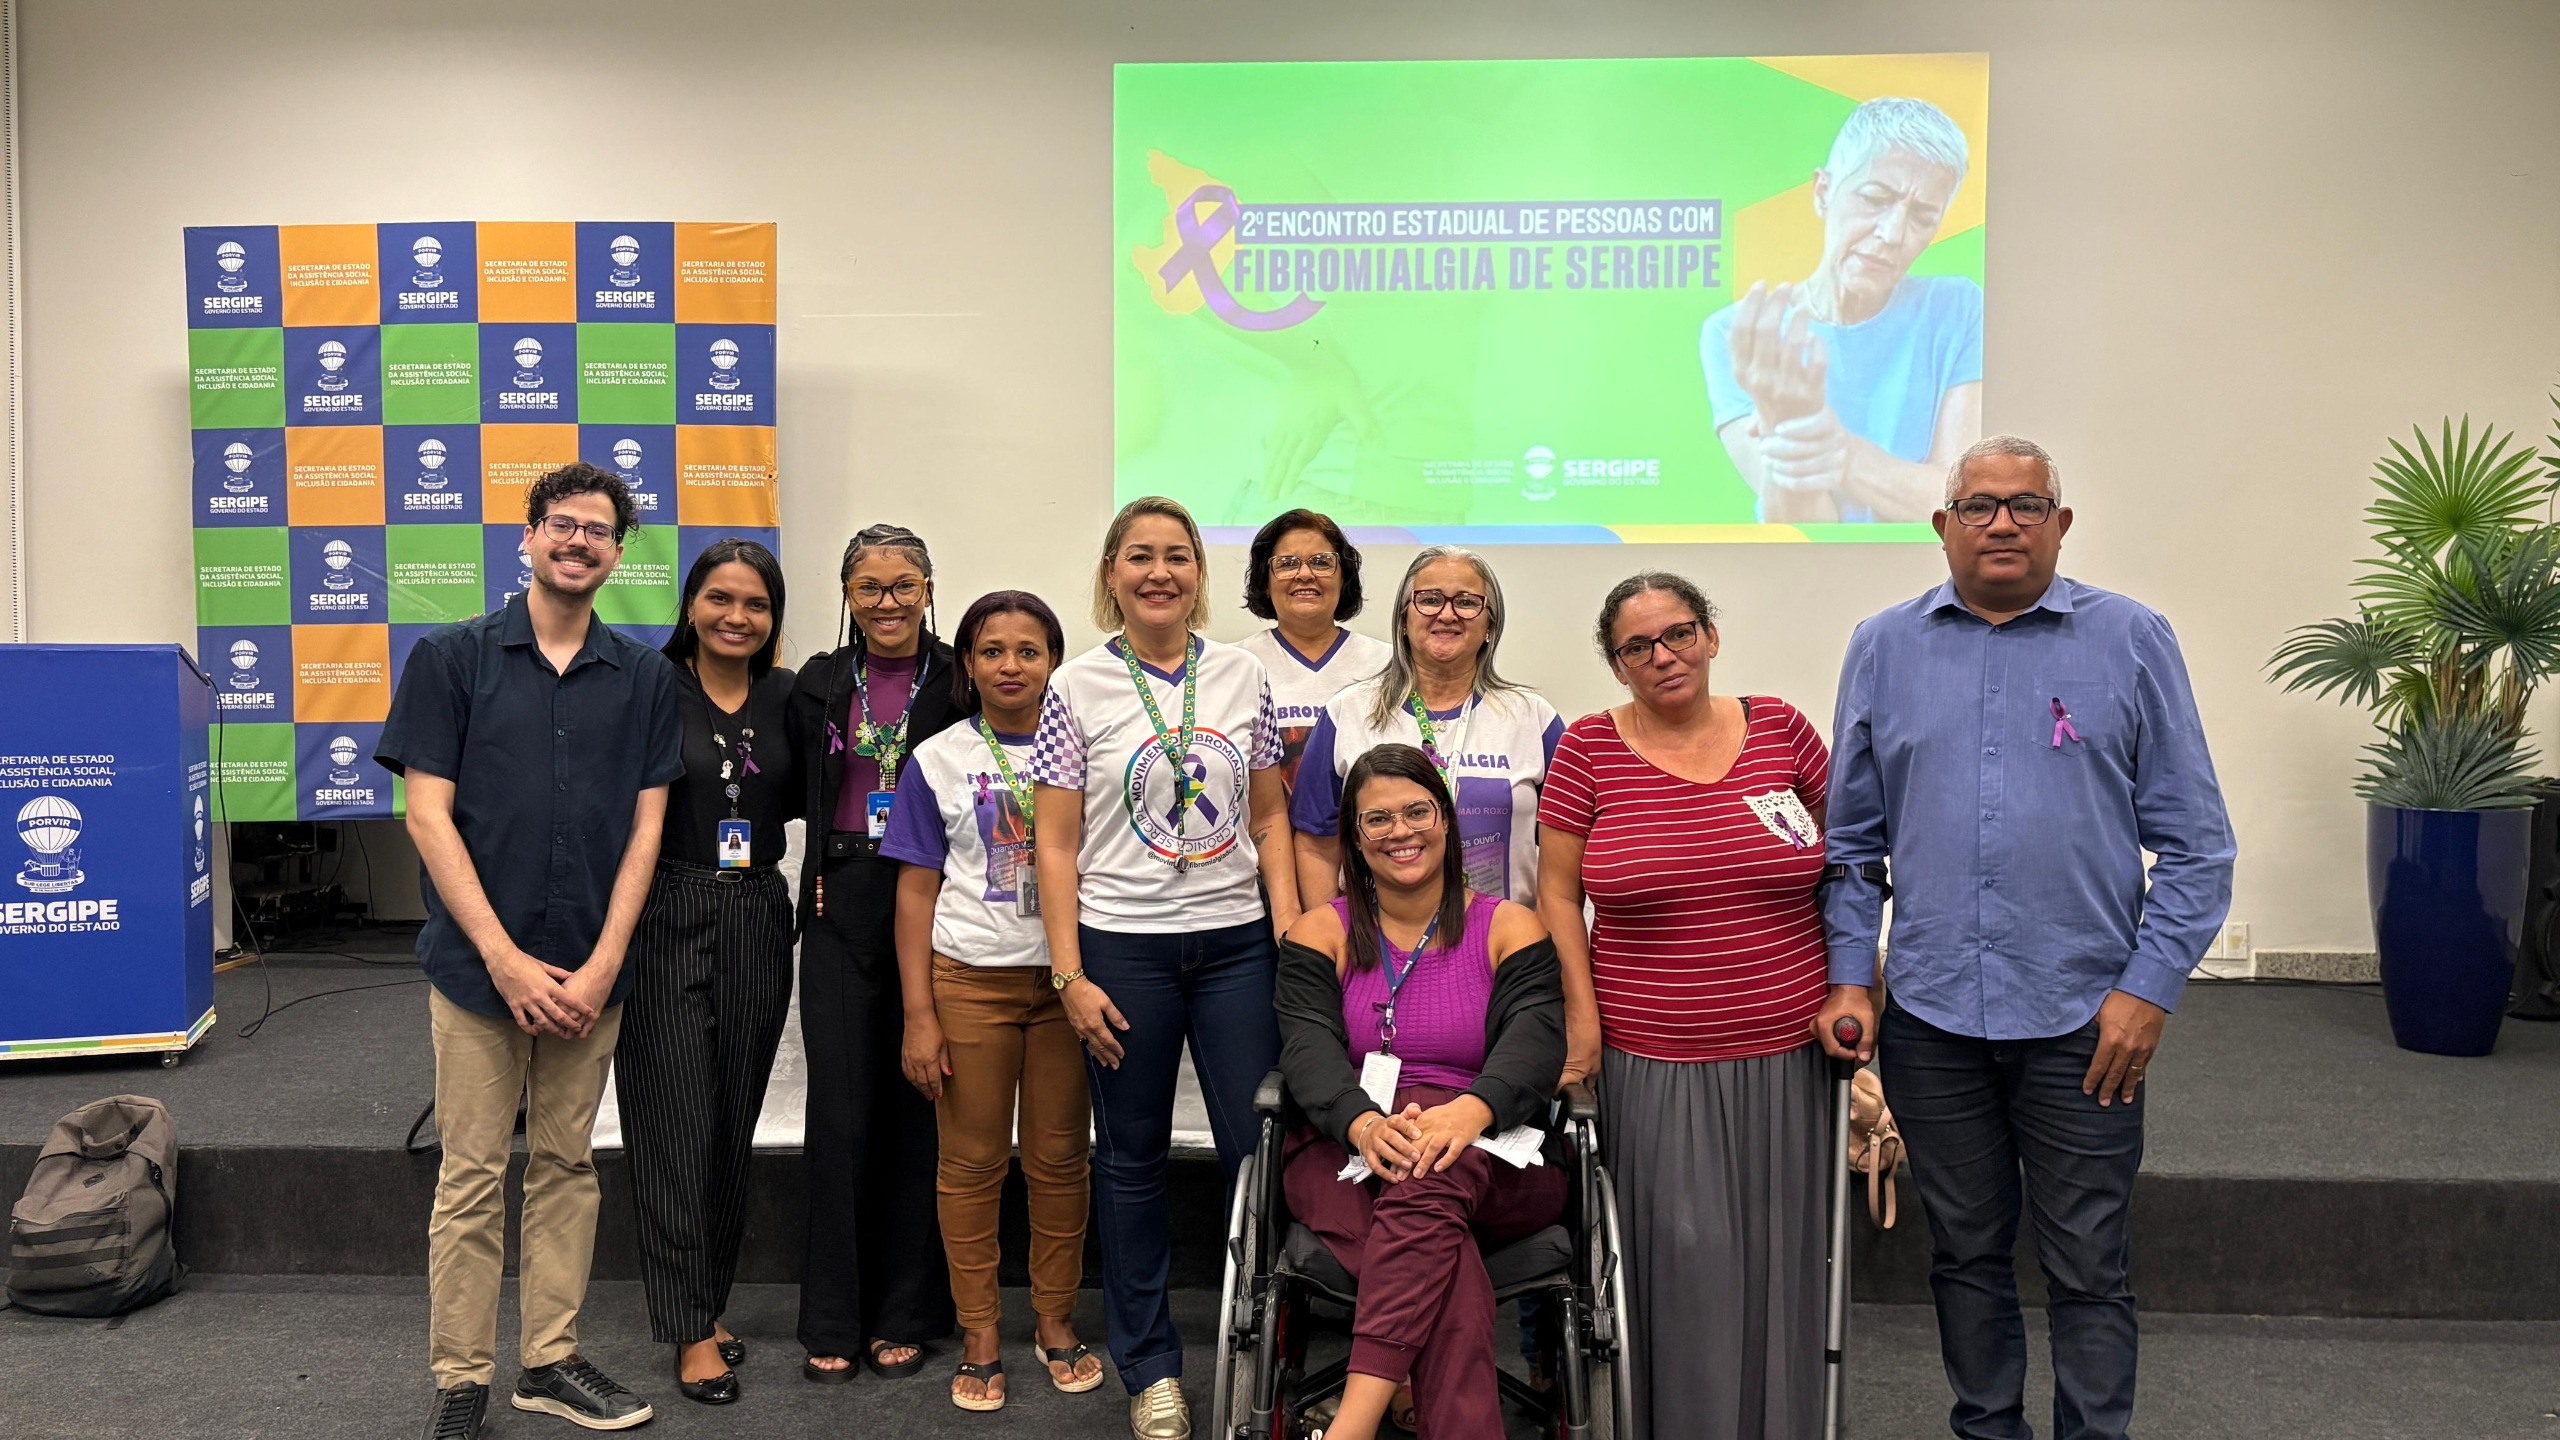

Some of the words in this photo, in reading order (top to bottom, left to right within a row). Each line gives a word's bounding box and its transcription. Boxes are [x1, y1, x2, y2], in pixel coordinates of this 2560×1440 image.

[1267, 210, 1386, 237] ENCONTRO
[1393, 209, 1513, 236] ESTADUAL
[1520, 208, 1550, 235] DE
[1556, 207, 1662, 234] PESSOAS
[1669, 206, 1714, 233] COM
[1234, 247, 1496, 293] FIBROMIALGIA
[1509, 245, 1554, 291] DE
[1566, 244, 1721, 290] SERGIPE
[204, 296, 263, 309] SERGIPE
[399, 291, 458, 304] SERGIPE
[596, 291, 655, 302] SERGIPE
[304, 394, 363, 407] SERGIPE
[499, 392, 558, 404] SERGIPE
[695, 394, 754, 405] SERGIPE
[1563, 459, 1660, 478] SERGIPE
[210, 496, 268, 508] SERGIPE
[404, 493, 463, 505] SERGIPE
[310, 593, 368, 605] SERGIPE
[0, 756, 49, 764] RETARIA
[52, 755, 67, 764] DE
[70, 755, 114, 763] ESTADO
[0, 766, 71, 776] ASSISTÊNCIA
[74, 766, 116, 776] SOCIAL,
[0, 778, 39, 788] LUSÃO
[42, 779, 49, 787] E
[52, 778, 112, 787] CIDADANIA
[315, 789, 374, 800] SERGIPE
[29, 818, 71, 827] PORVIR
[1474, 832, 1501, 846] ouvir?
[0, 899, 118, 923] ERGIPE
[0, 924, 46, 934] VERNO
[49, 923, 67, 933] DO
[70, 922, 120, 932] ESTADO
